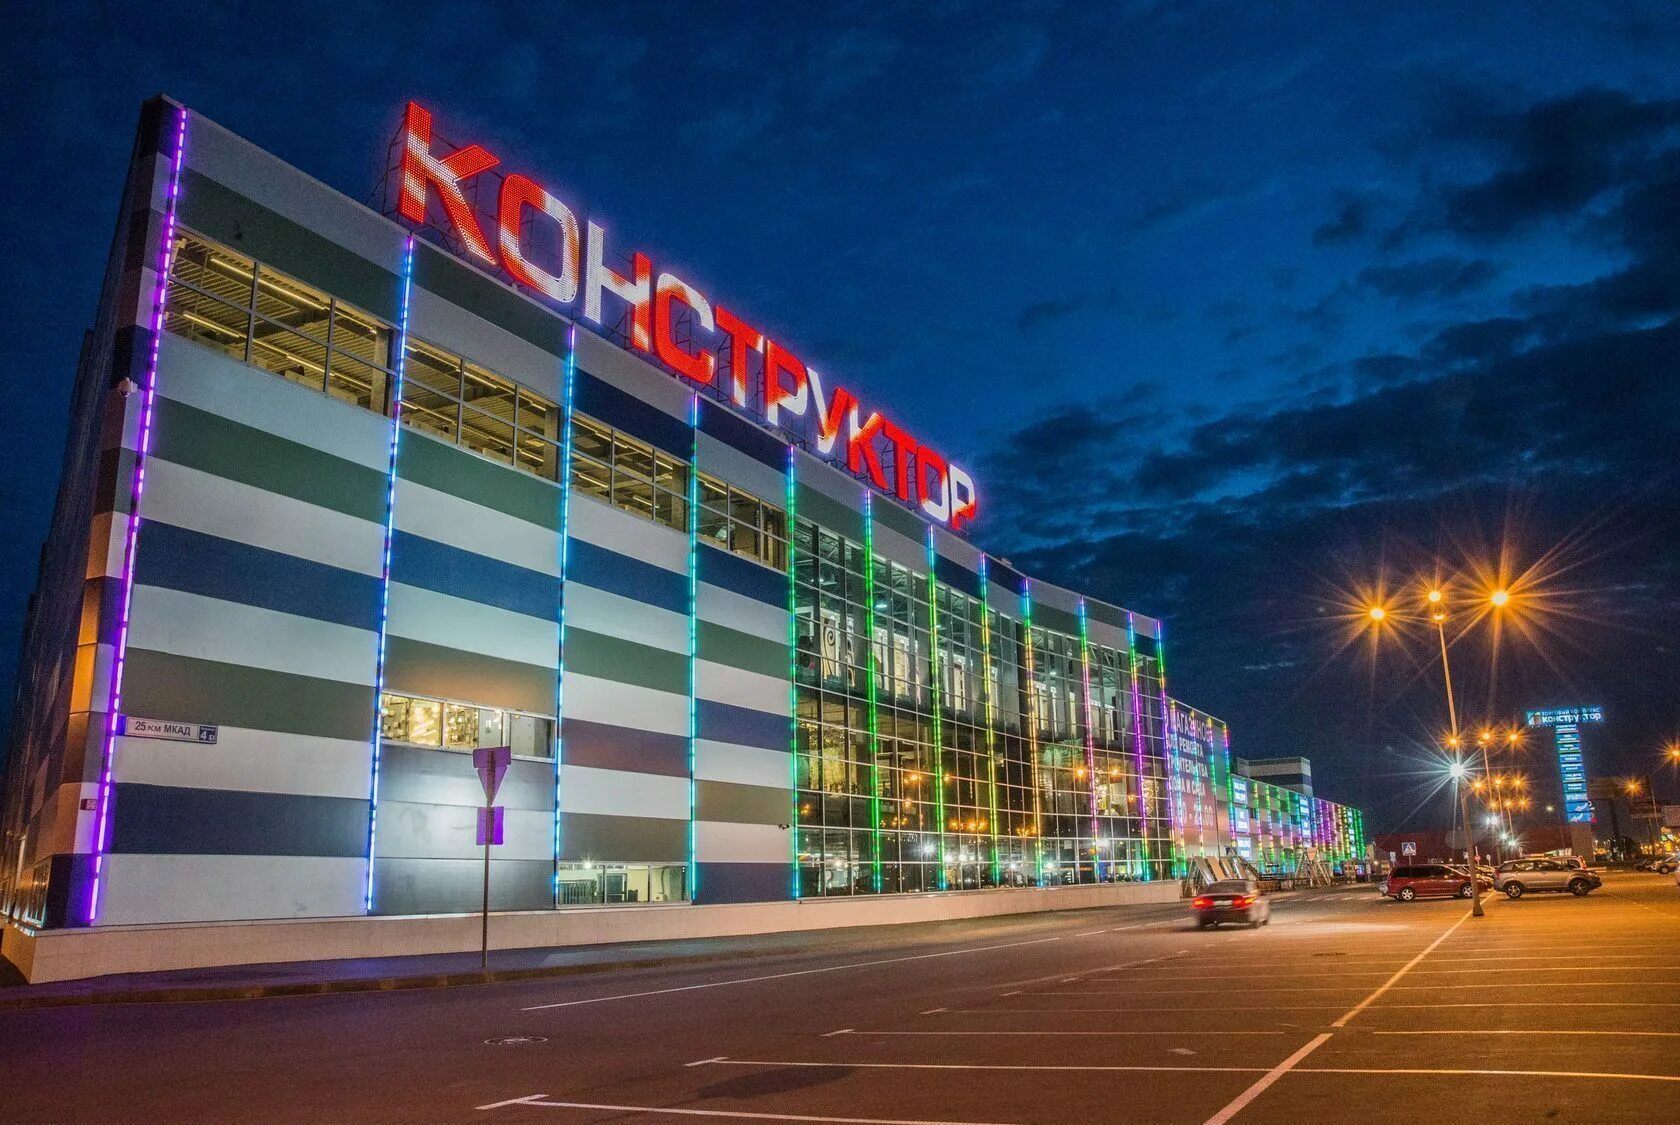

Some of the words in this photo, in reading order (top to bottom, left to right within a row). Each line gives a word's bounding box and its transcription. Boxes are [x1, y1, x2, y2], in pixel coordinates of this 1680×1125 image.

[398, 100, 978, 532] КОНСТРУКТОР
[135, 721, 147, 732] 25
[147, 725, 161, 733] км
[163, 724, 191, 736] МКАД
[200, 731, 207, 740] 4
[1179, 736, 1203, 757] РЕМОТА
